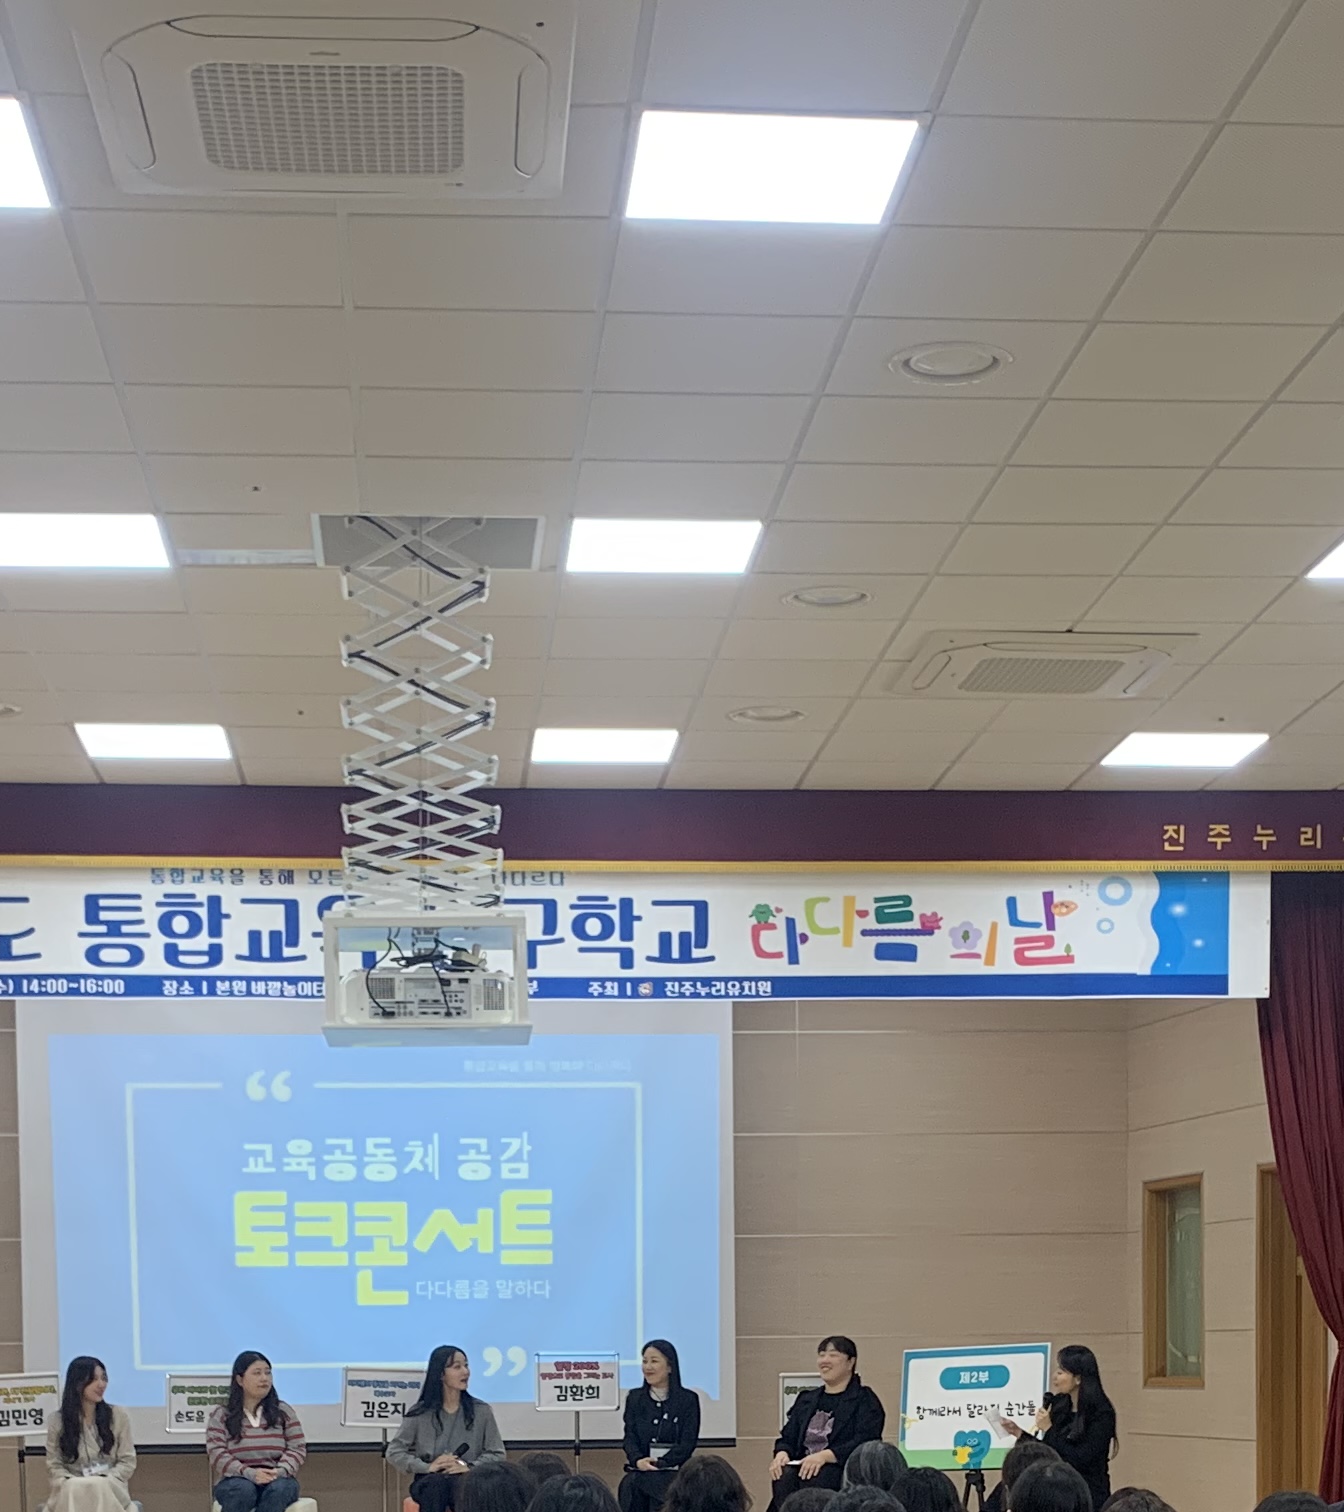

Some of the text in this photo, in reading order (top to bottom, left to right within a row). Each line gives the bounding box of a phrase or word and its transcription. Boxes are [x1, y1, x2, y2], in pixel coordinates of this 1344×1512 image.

[150, 868, 245, 886] 통합교육을
[258, 868, 295, 886] 통해
[502, 895, 716, 970] 구학교
[22, 977, 125, 995] 14:00~16:00
[162, 979, 195, 996] 장소
[215, 979, 247, 996] 본원
[588, 981, 619, 996] 주최
[664, 981, 772, 997] 진주누리유치원
[242, 1131, 532, 1182] 교육공동체 공감
[234, 1189, 553, 1306] 토크콘서트
[415, 1279, 552, 1300] 다다름을 말하다
[958, 1369, 990, 1385] 제2부
[553, 1383, 600, 1402] 김환희
[360, 1401, 406, 1419] 김은지
